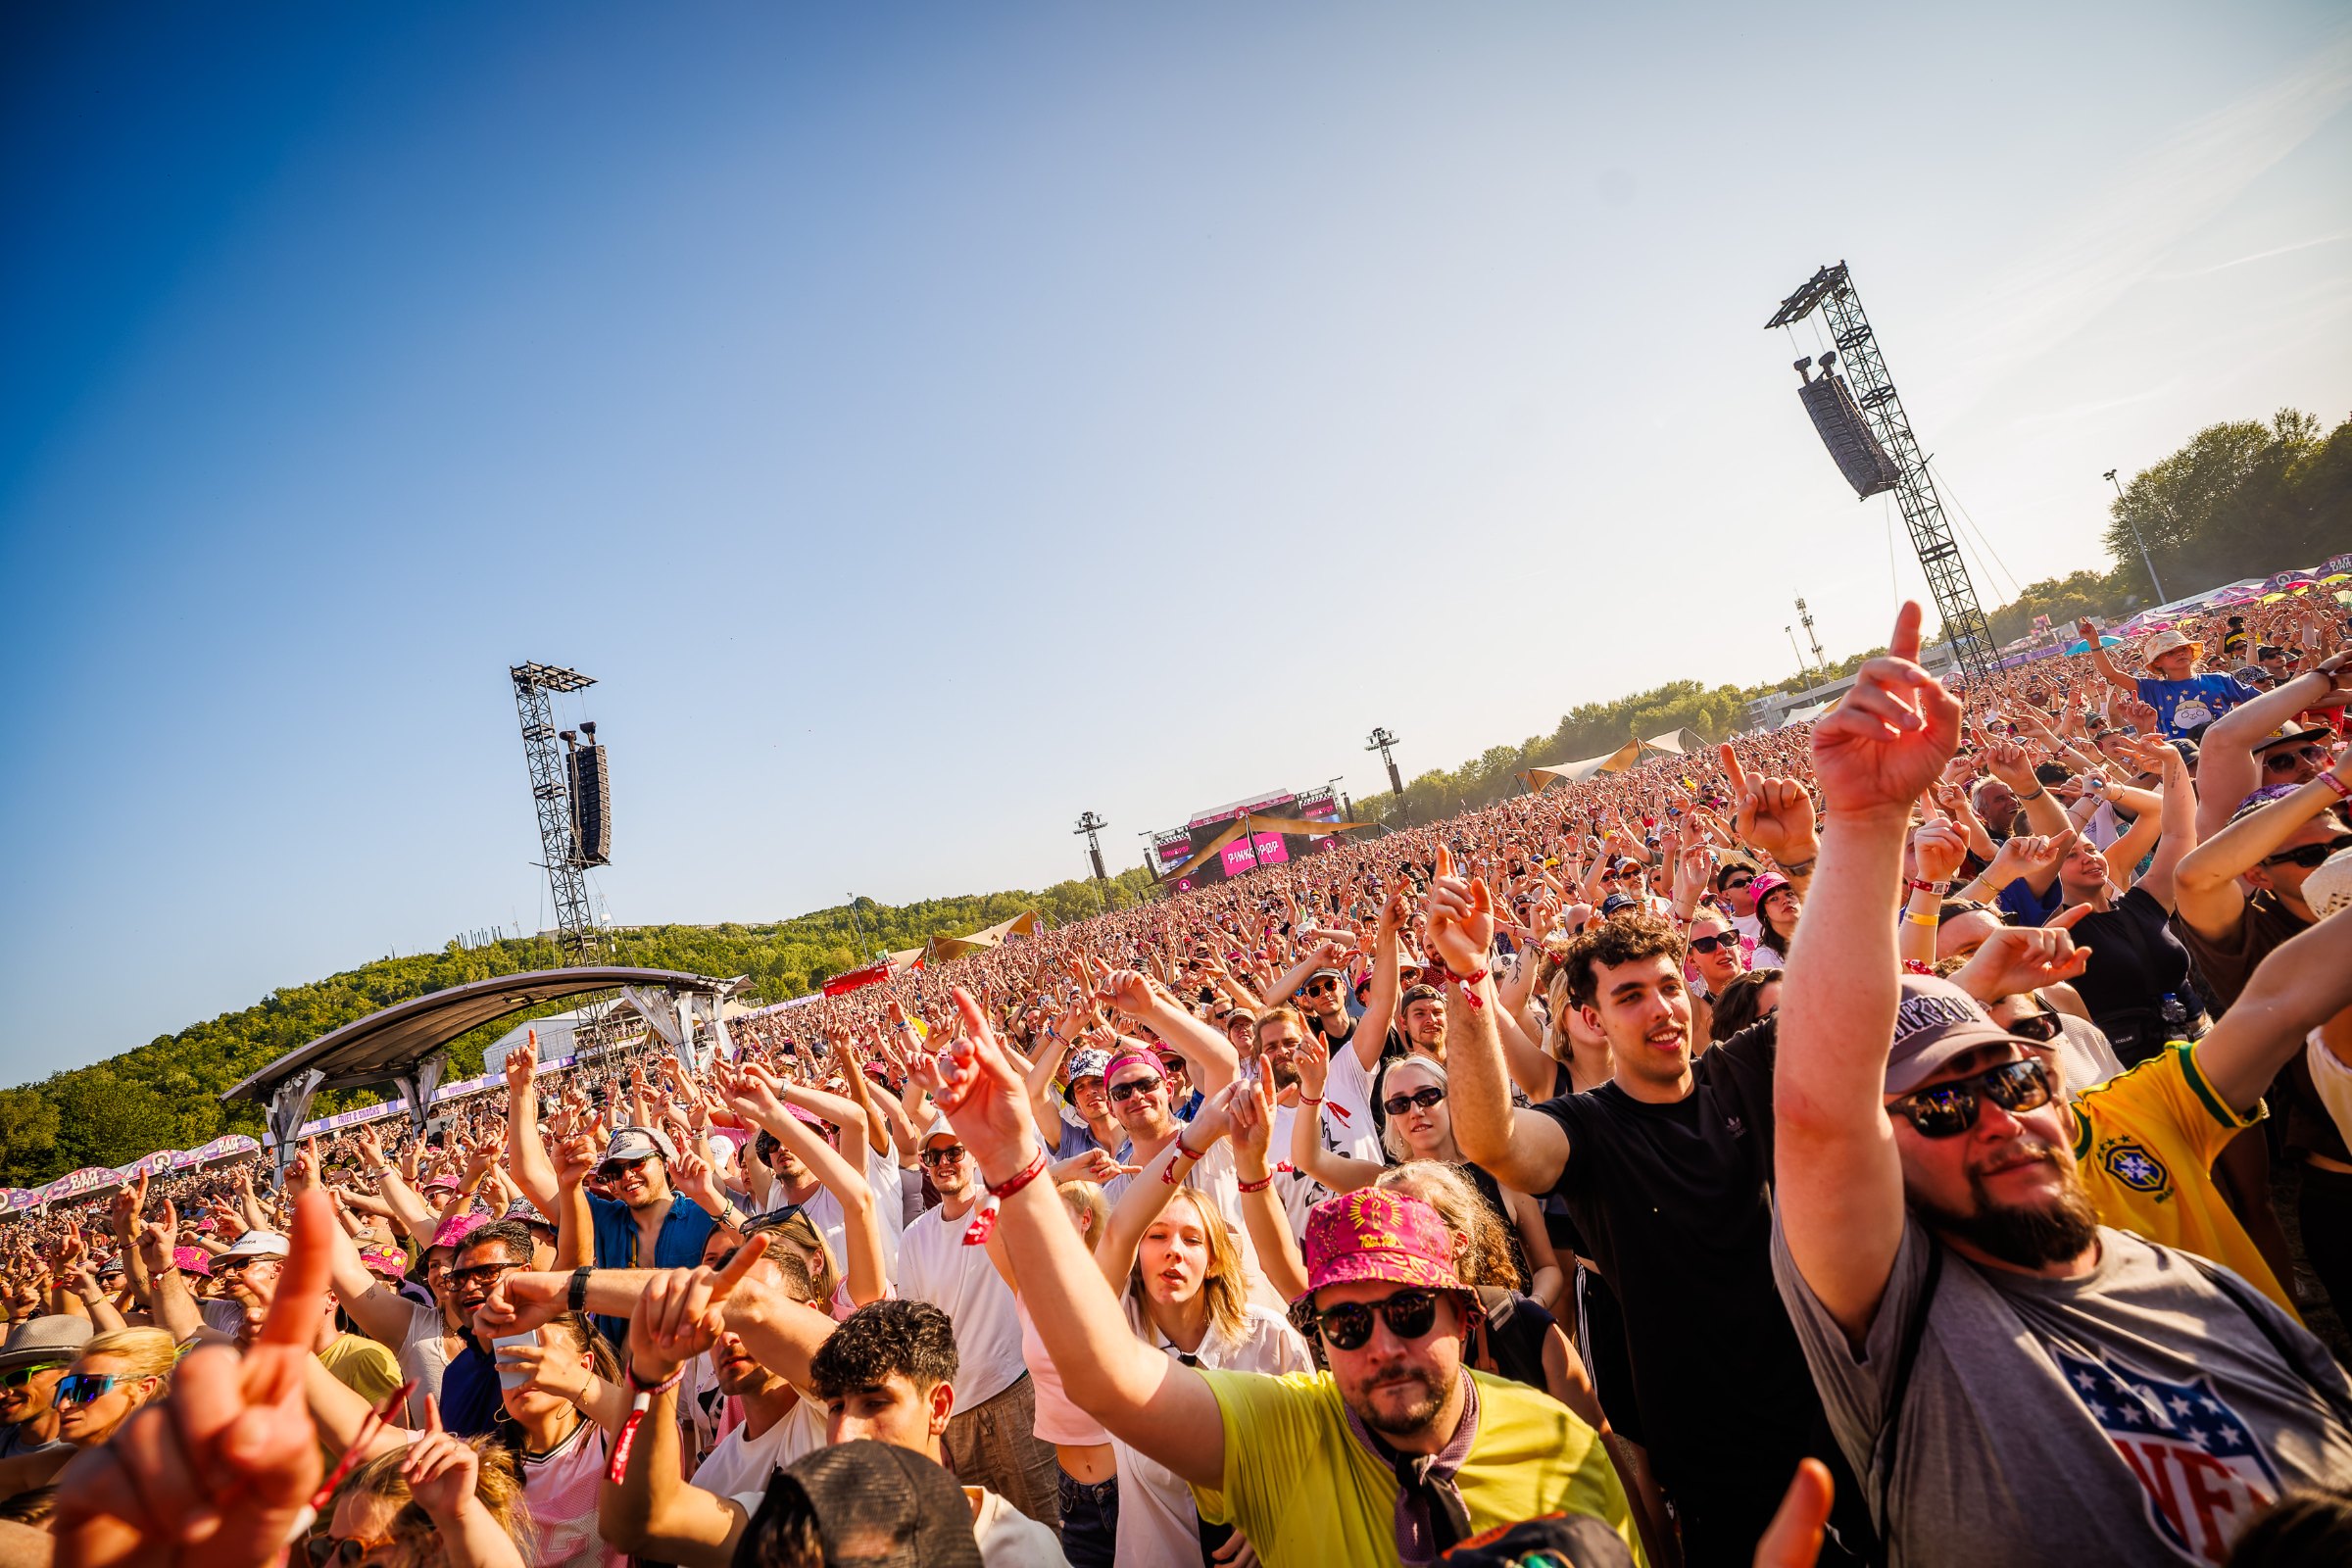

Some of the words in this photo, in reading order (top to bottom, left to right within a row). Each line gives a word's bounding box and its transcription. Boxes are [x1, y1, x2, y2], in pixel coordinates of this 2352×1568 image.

[2328, 557, 2352, 572] BAR
[337, 1113, 353, 1125] FRIET
[353, 1111, 358, 1120] &
[359, 1105, 380, 1119] SNACKS
[217, 1138, 239, 1153] BAR
[71, 1169, 99, 1191] BAR
[2113, 1438, 2272, 1565] NF
